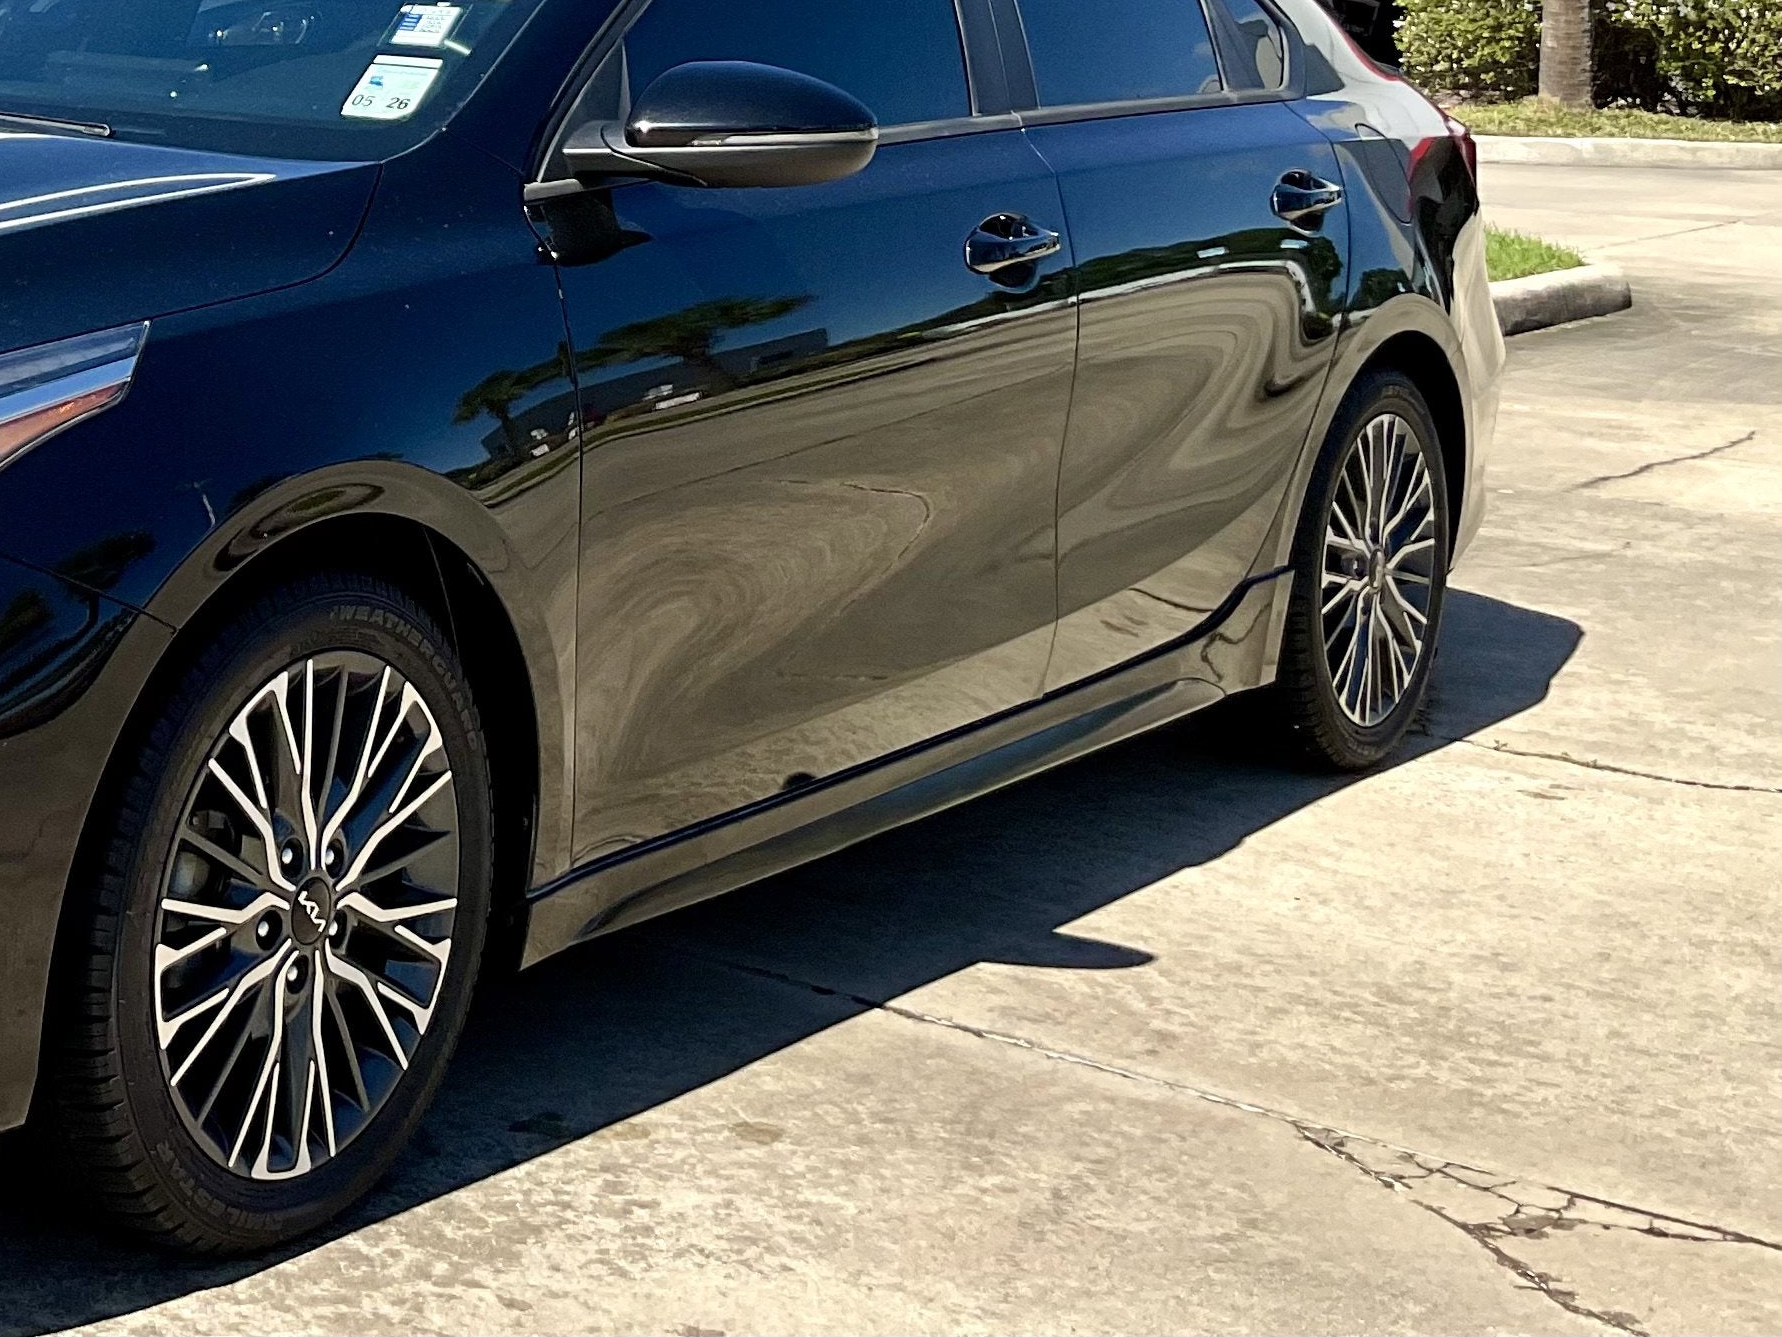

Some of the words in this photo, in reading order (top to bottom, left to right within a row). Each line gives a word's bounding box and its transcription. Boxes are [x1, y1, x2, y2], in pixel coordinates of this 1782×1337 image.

[351, 94, 376, 107] 05
[386, 96, 411, 110] 26
[338, 605, 477, 751] WEATHERGUARD
[298, 890, 326, 933] KIA
